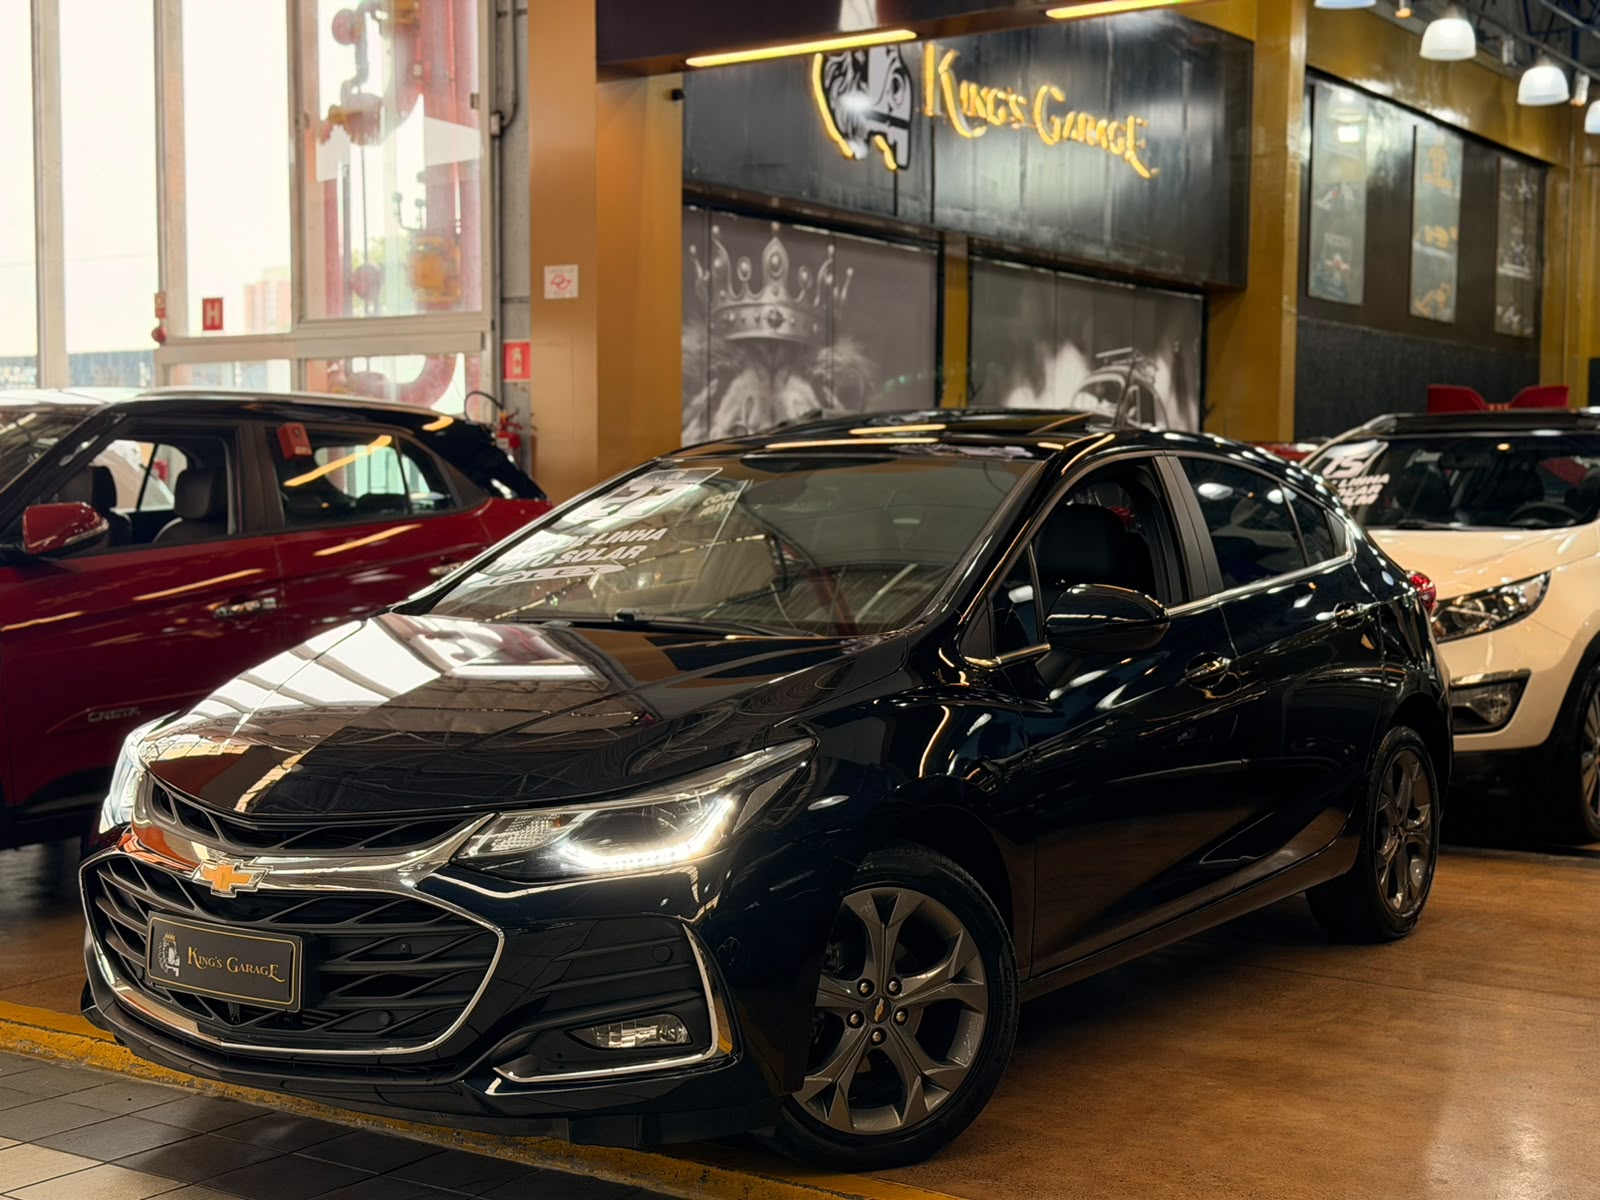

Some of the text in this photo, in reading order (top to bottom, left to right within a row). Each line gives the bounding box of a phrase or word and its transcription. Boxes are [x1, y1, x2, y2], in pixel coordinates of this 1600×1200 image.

[1032, 84, 1160, 178] GARAGE
[591, 527, 669, 546] LINHA
[553, 544, 648, 565] SOLAR
[187, 946, 285, 983] KING'S GARAGE
